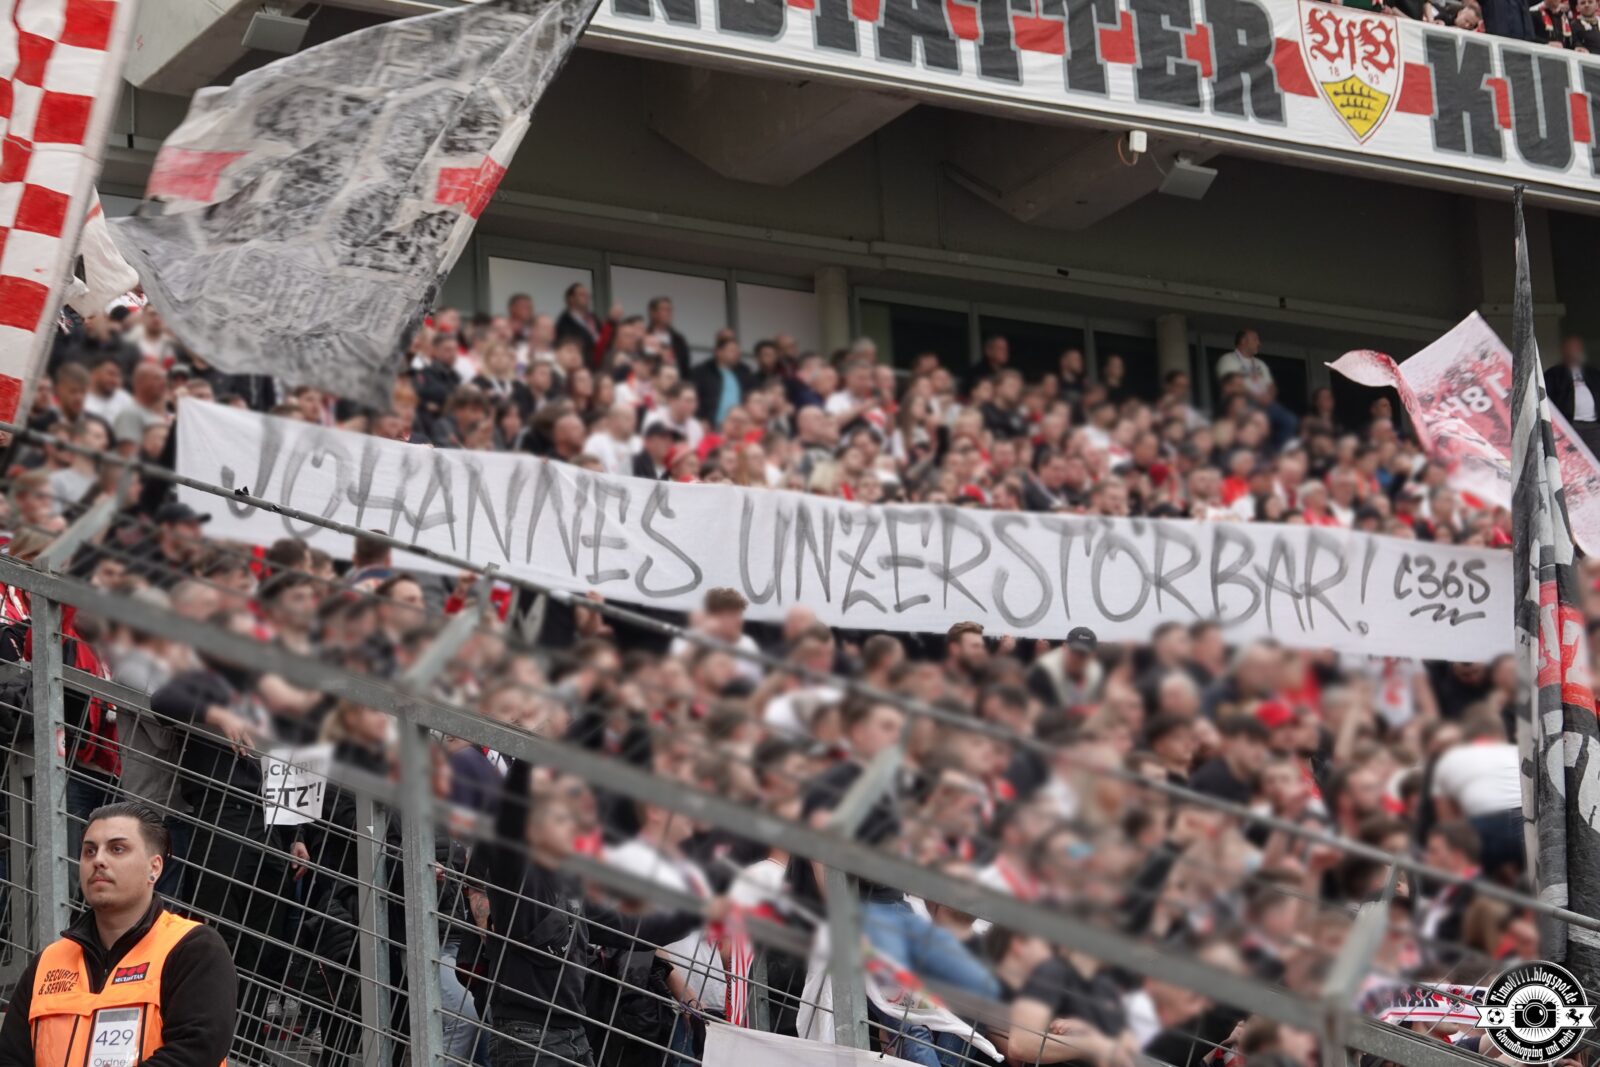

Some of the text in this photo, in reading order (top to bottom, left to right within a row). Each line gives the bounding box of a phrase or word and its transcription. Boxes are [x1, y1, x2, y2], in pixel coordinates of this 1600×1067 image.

[1422, 28, 1600, 179] KU
[221, 413, 702, 598] JOHANNES
[739, 495, 1377, 636] UNZERSTÖRBAR!
[95, 1029, 134, 1046] 429
